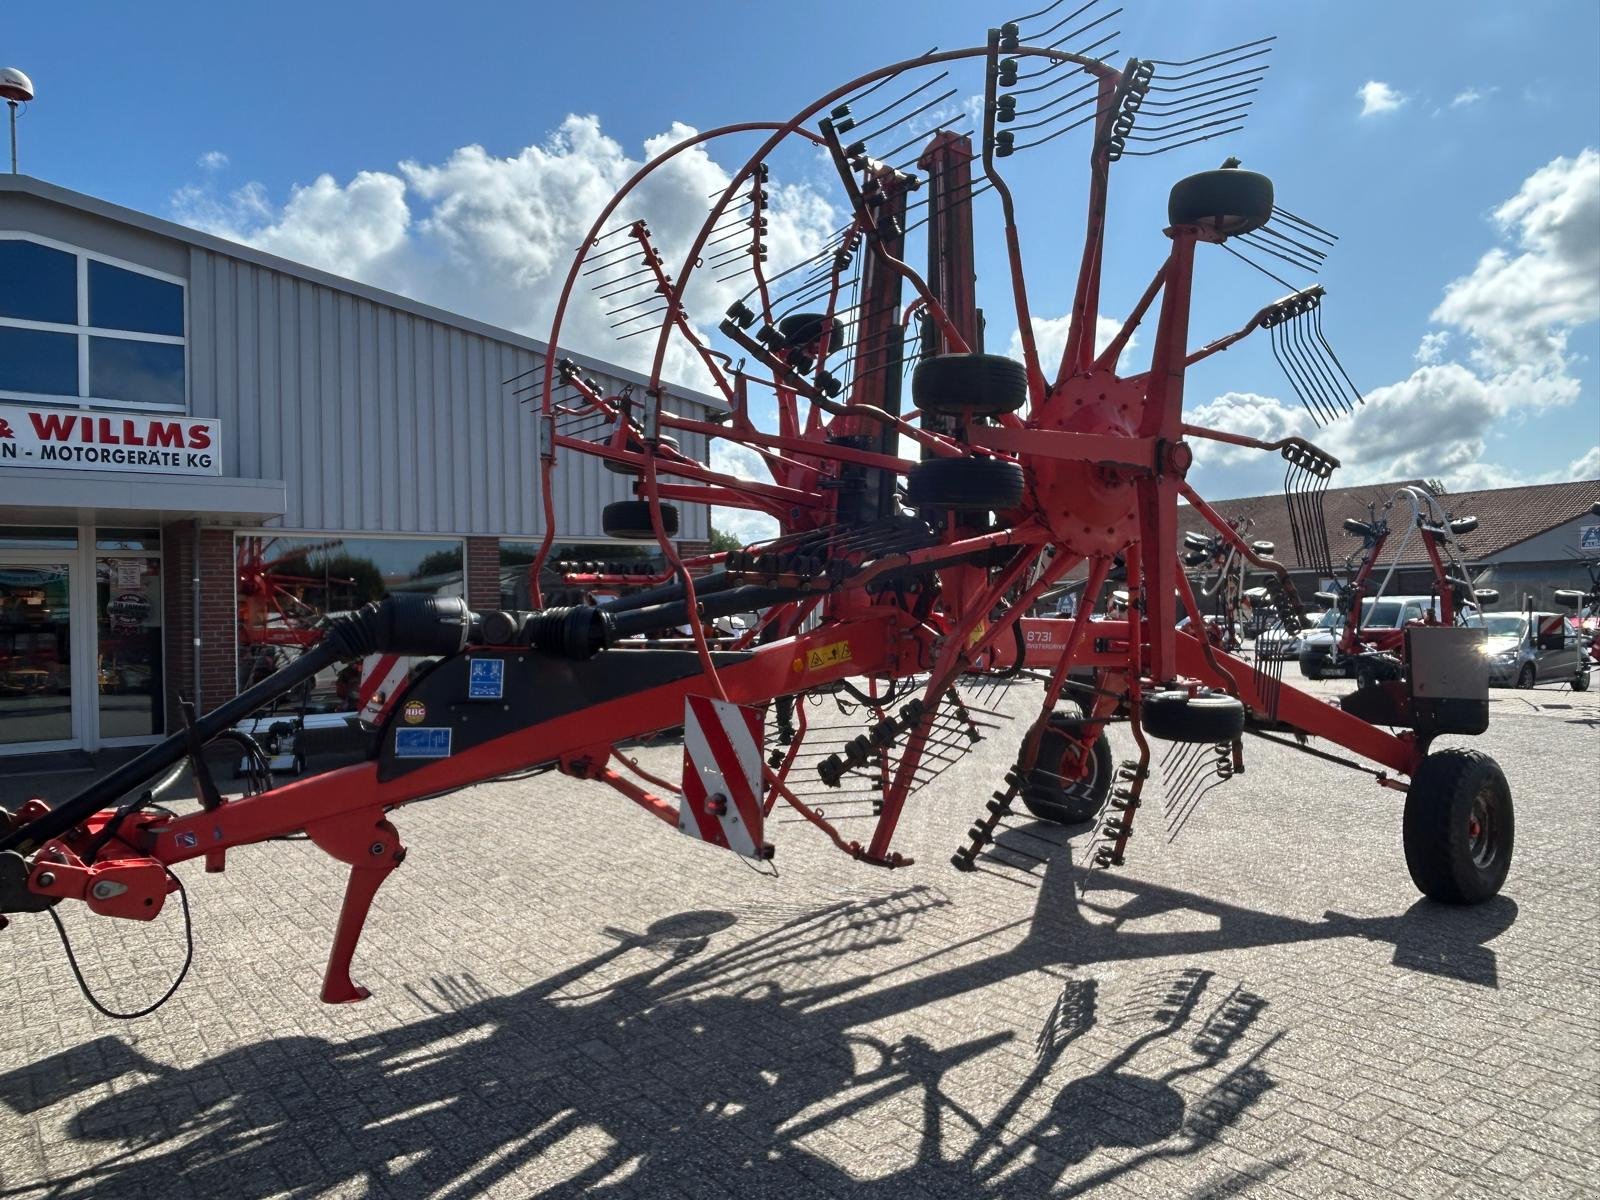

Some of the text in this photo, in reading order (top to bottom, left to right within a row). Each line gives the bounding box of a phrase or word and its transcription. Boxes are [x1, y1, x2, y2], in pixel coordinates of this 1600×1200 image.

[28, 412, 212, 449] WILLMS
[40, 444, 180, 467] MOTORGERÄTE
[187, 453, 212, 468] KG
